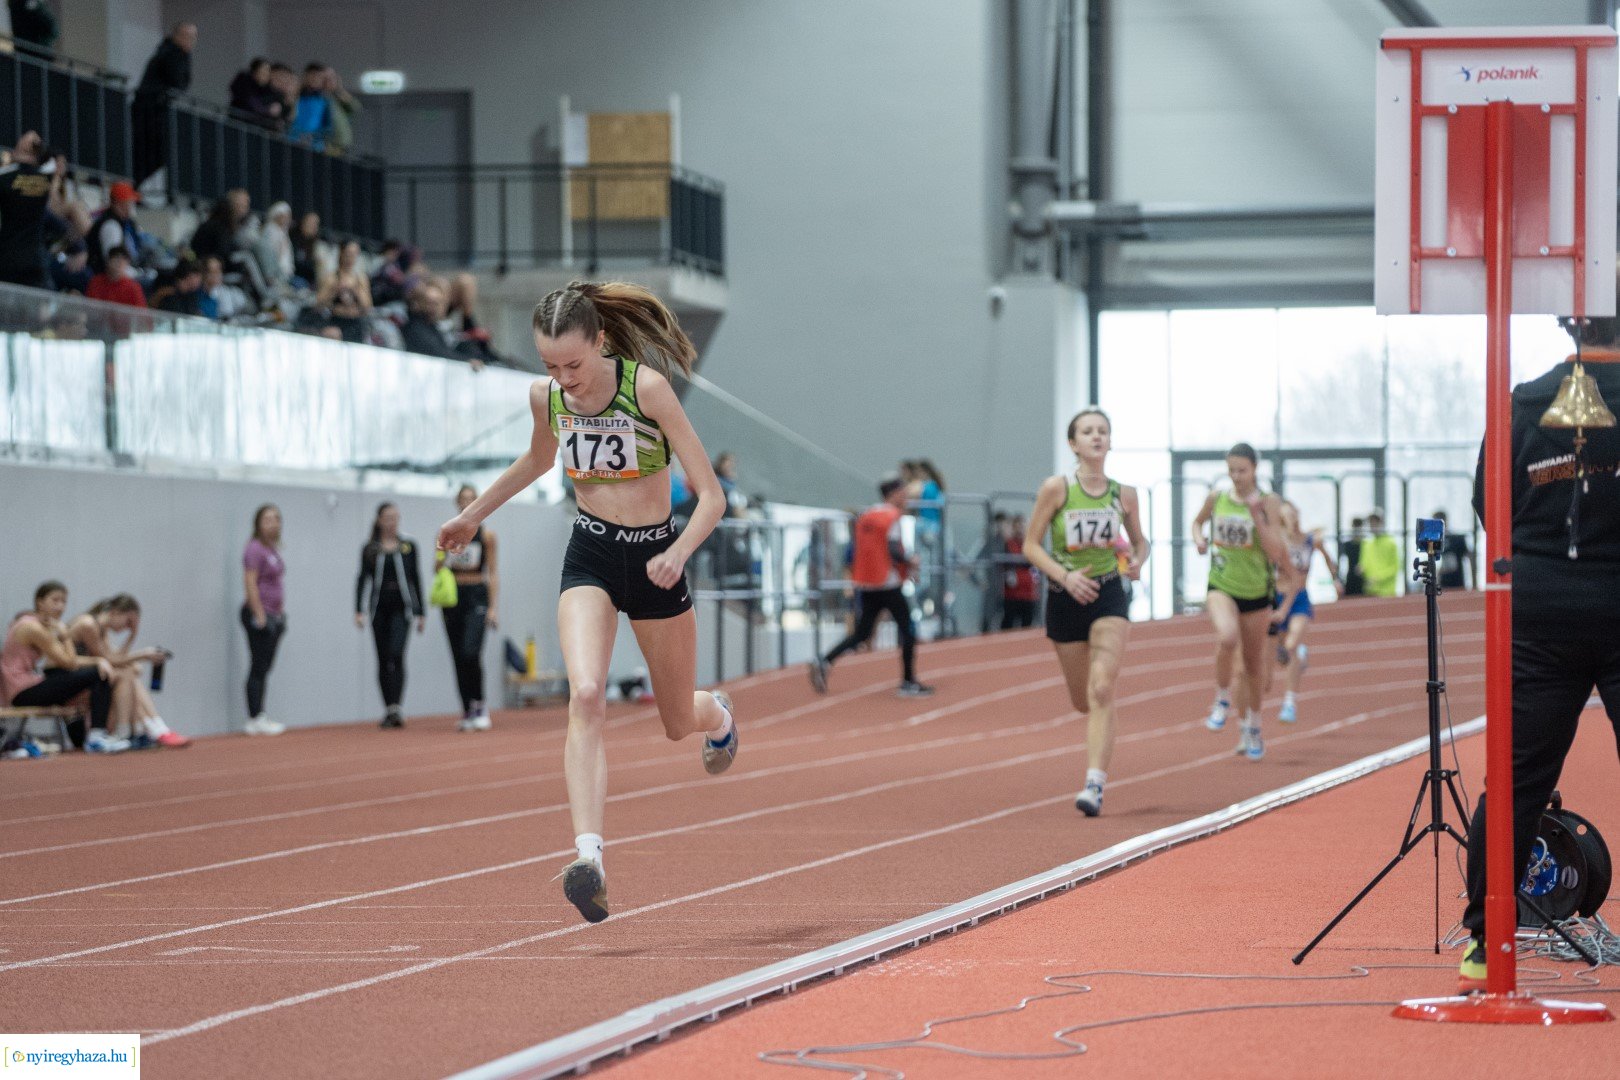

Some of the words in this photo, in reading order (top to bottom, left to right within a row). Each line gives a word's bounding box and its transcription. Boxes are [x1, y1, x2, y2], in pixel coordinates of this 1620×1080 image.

[1477, 65, 1538, 83] polanik
[573, 417, 630, 428] STABILITA
[566, 432, 627, 471] 173
[615, 525, 668, 543] NIKE
[1073, 520, 1113, 543] 174
